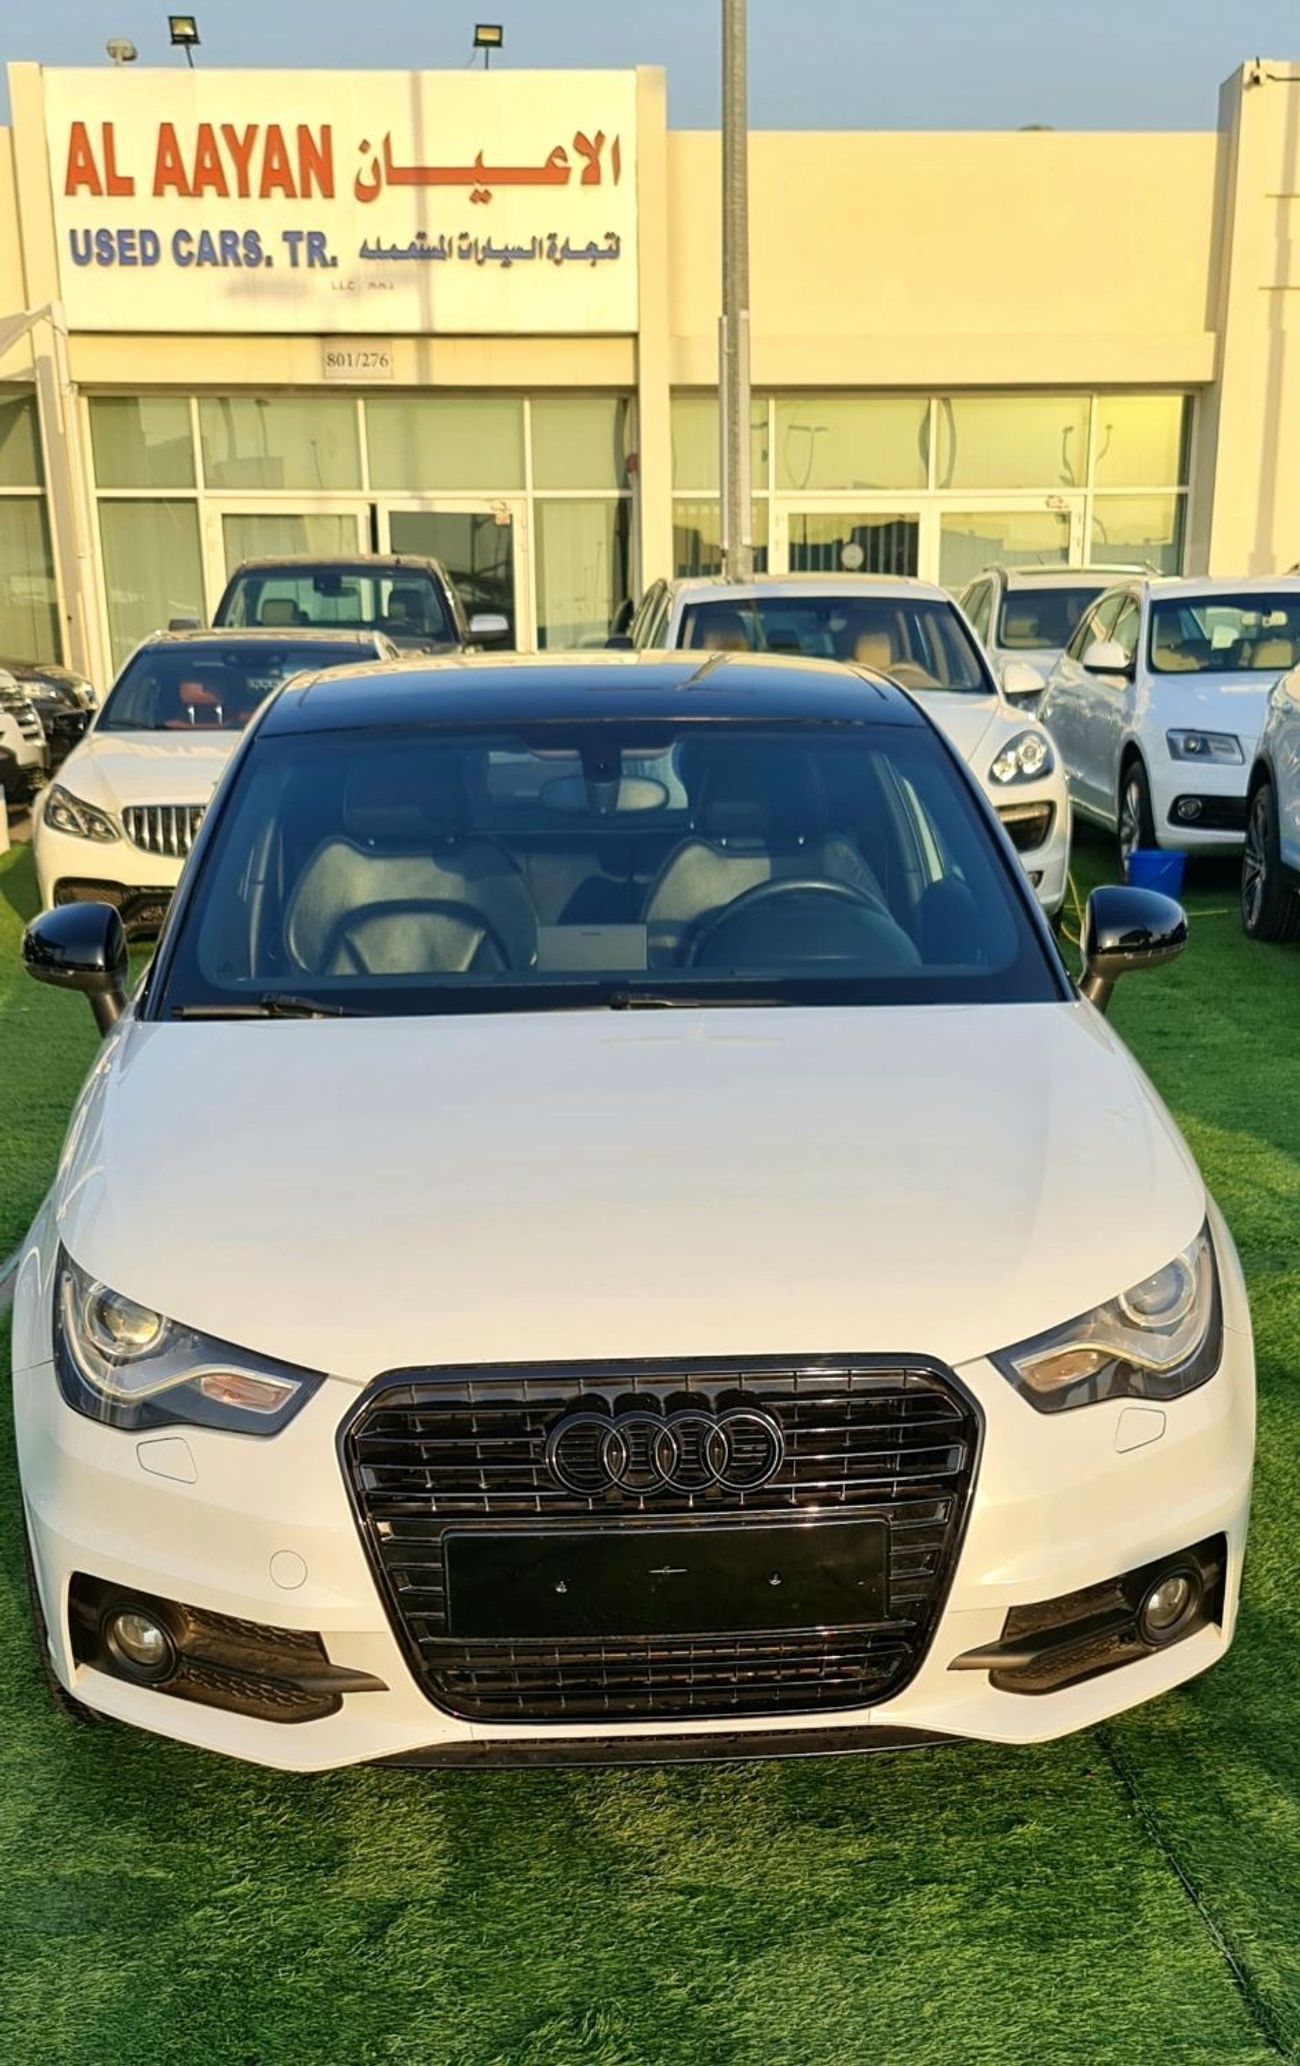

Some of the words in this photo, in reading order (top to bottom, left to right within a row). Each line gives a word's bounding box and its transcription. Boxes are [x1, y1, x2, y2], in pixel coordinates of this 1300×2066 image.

[64, 121, 135, 197] AL
[152, 122, 335, 199] AAYAN
[354, 130, 621, 204] الاعيان
[69, 228, 160, 267] USED
[171, 228, 273, 267] CARS.
[282, 230, 338, 267] TR.
[326, 352, 390, 368] 801/276
